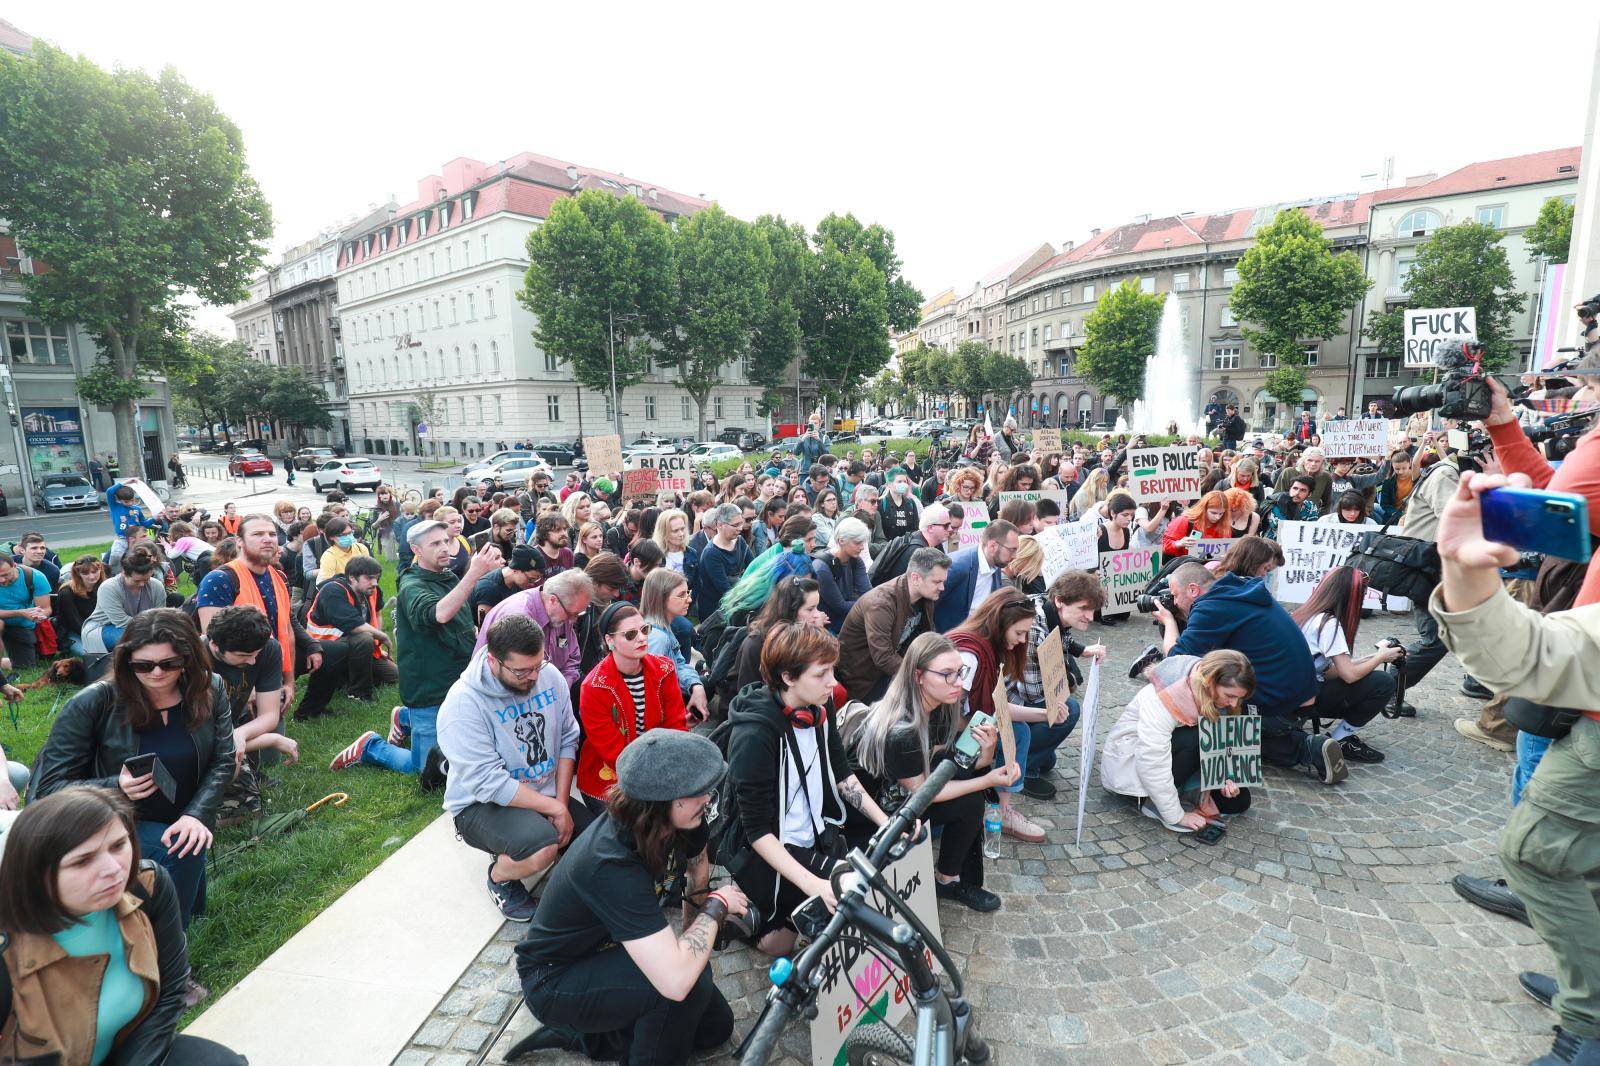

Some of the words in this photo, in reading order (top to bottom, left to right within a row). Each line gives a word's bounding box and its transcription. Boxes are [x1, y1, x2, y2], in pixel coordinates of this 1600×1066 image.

[1412, 311, 1471, 335] FUCK
[1407, 338, 1447, 363] RAC
[641, 457, 685, 470] BLACK
[1132, 454, 1159, 467] END
[1163, 452, 1198, 471] POLICE
[628, 469, 657, 483] GEORGE
[657, 470, 673, 478] ES
[624, 481, 652, 493] FLOYD
[656, 479, 686, 490] ATTER
[1140, 478, 1199, 495] BRUTALITY
[1001, 494, 1021, 502] NISAM
[1024, 493, 1041, 501] CRNA
[1299, 526, 1305, 543] I
[1197, 543, 1230, 555] JUST
[1112, 550, 1151, 572] STOP
[1287, 548, 1326, 569] THAT
[1113, 570, 1152, 588] FUNDING
[495, 687, 558, 724] YOUTH
[1200, 716, 1260, 752] SILENCE
[1200, 754, 1263, 788] VIOLENCE
[837, 1003, 852, 1033] is
